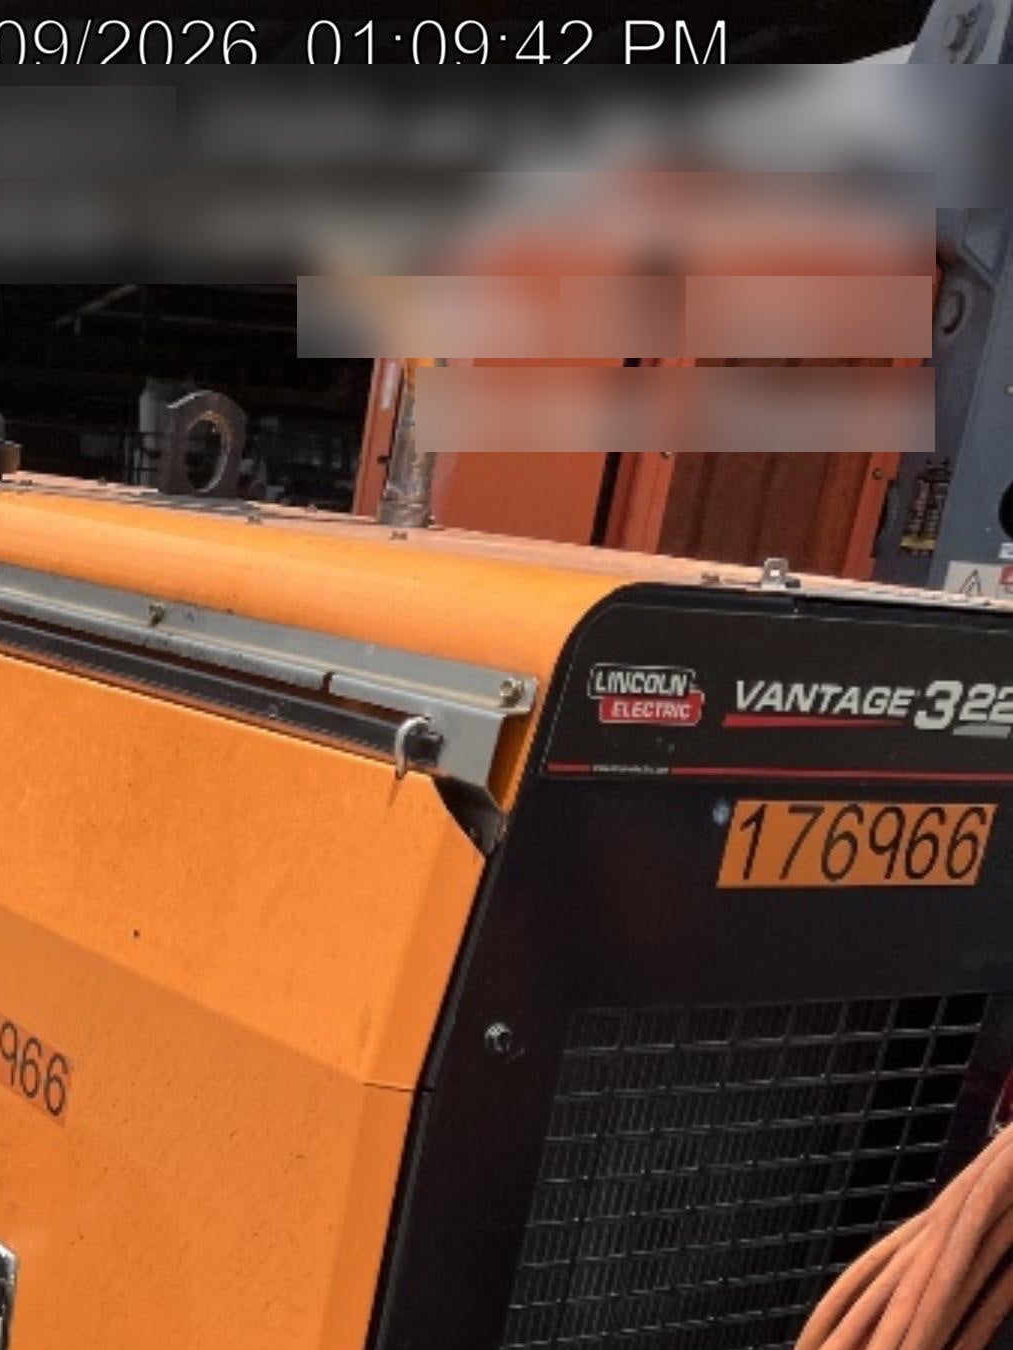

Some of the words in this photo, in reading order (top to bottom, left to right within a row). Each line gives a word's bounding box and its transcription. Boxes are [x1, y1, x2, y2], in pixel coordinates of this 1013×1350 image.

[594, 670, 689, 697] LINCOLN
[736, 680, 916, 718] VANTAGE
[610, 701, 692, 721] ELECTRIC
[739, 803, 988, 882] 176966
